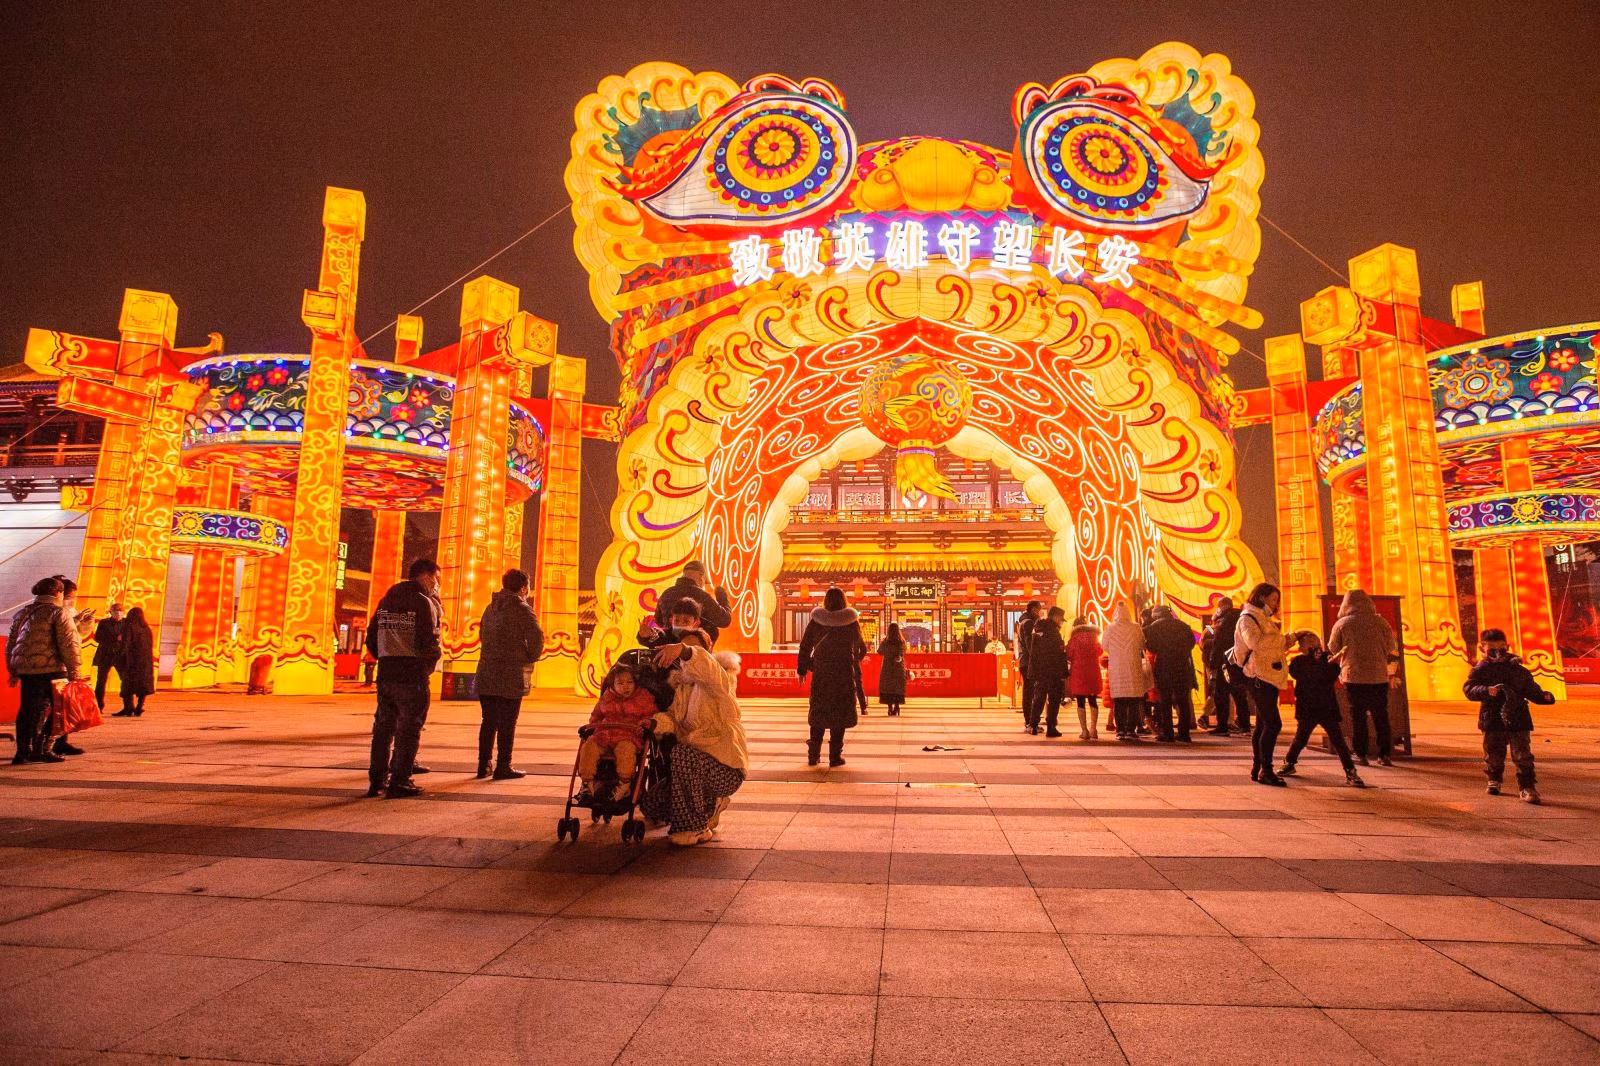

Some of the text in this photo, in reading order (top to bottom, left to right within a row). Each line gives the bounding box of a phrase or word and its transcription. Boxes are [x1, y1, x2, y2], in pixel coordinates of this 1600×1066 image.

[728, 220, 1140, 288] 致敬英雄守望长安
[845, 492, 880, 506] 英雄
